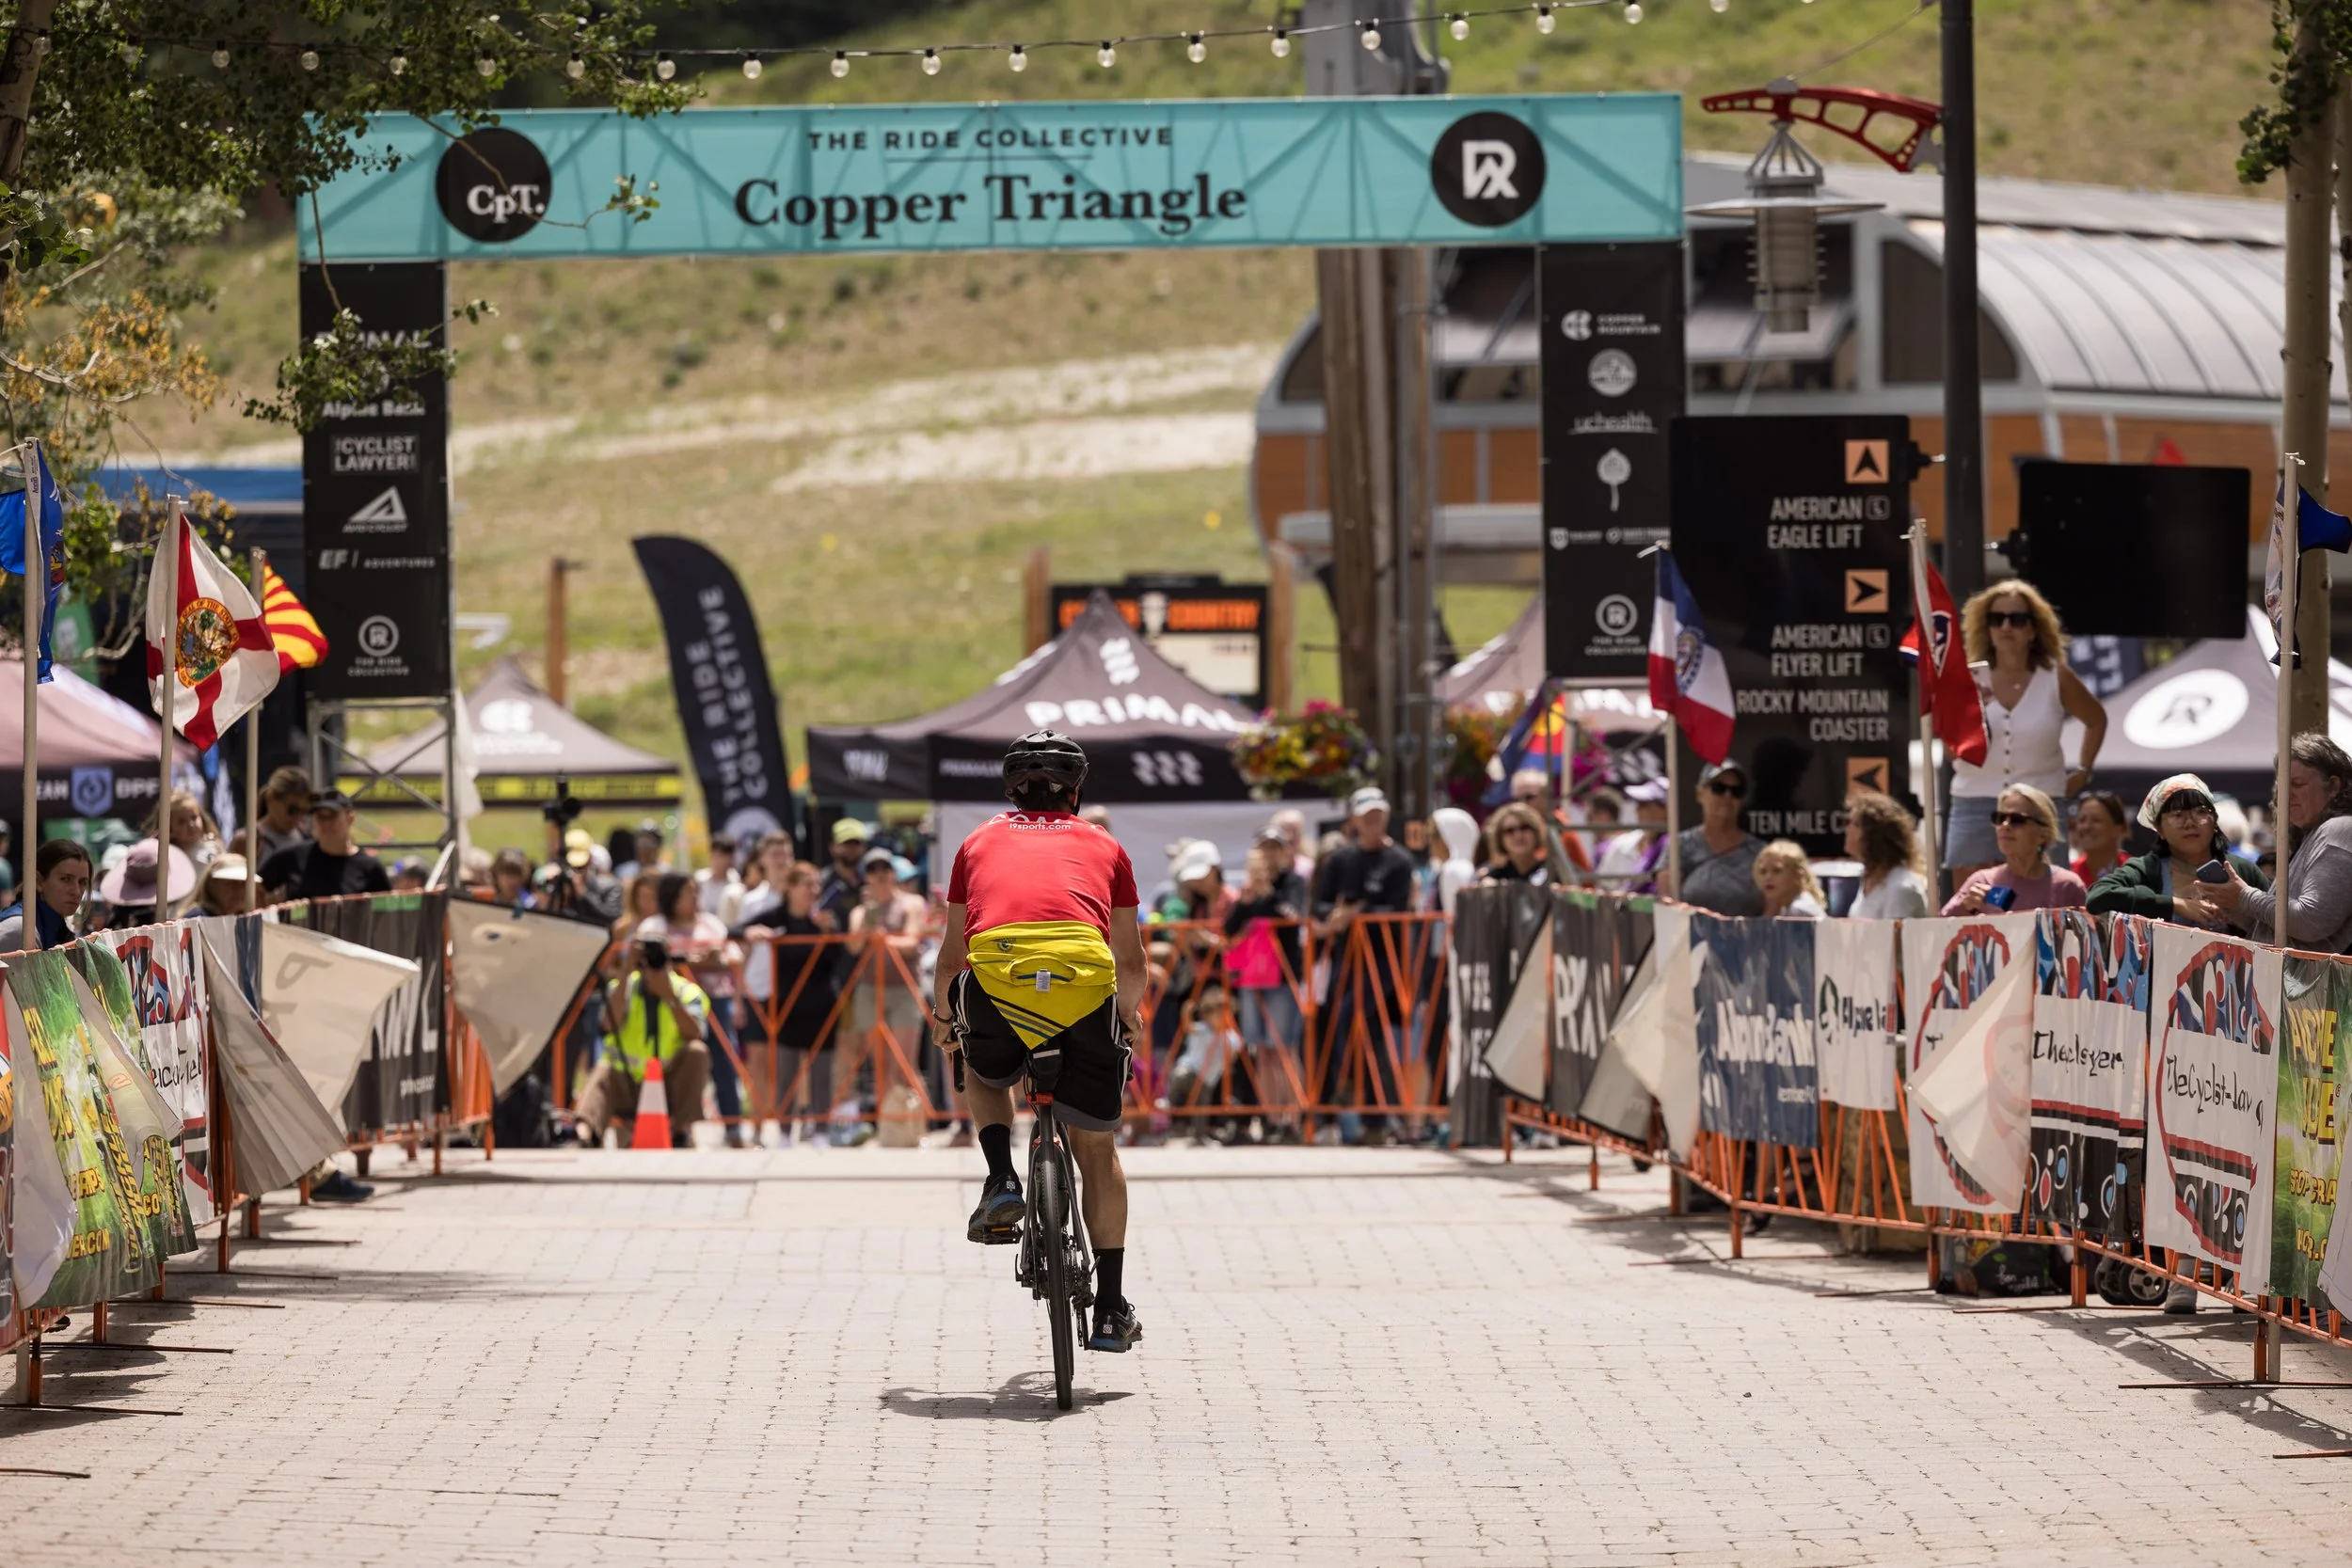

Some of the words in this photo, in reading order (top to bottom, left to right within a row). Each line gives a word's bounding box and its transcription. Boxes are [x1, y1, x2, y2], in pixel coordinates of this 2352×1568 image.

[807, 131, 868, 150] THE
[886, 128, 961, 150] RIDE
[976, 125, 1173, 148] COLLECTIVE
[735, 178, 966, 241] Copper
[984, 172, 1248, 236] Triangle
[1771, 497, 1863, 520] AMERICAN
[1767, 525, 1823, 548] EAGLE
[1826, 525, 1863, 548] LIFT
[318, 549, 348, 569] EF
[1771, 625, 1863, 648] AMERICAN
[1771, 653, 1823, 676] FLYER
[1827, 653, 1864, 676] LIFT
[1737, 689, 1794, 713] ROCKY
[1798, 689, 1889, 713] MOUNTAIN
[1809, 717, 1889, 741] COASTER
[710, 735, 743, 807] THE
[1747, 811, 1781, 834] TEN
[1787, 811, 1826, 834] MILE
[1830, 811, 1849, 834] C
[2311, 1176, 2338, 1206] CRA
